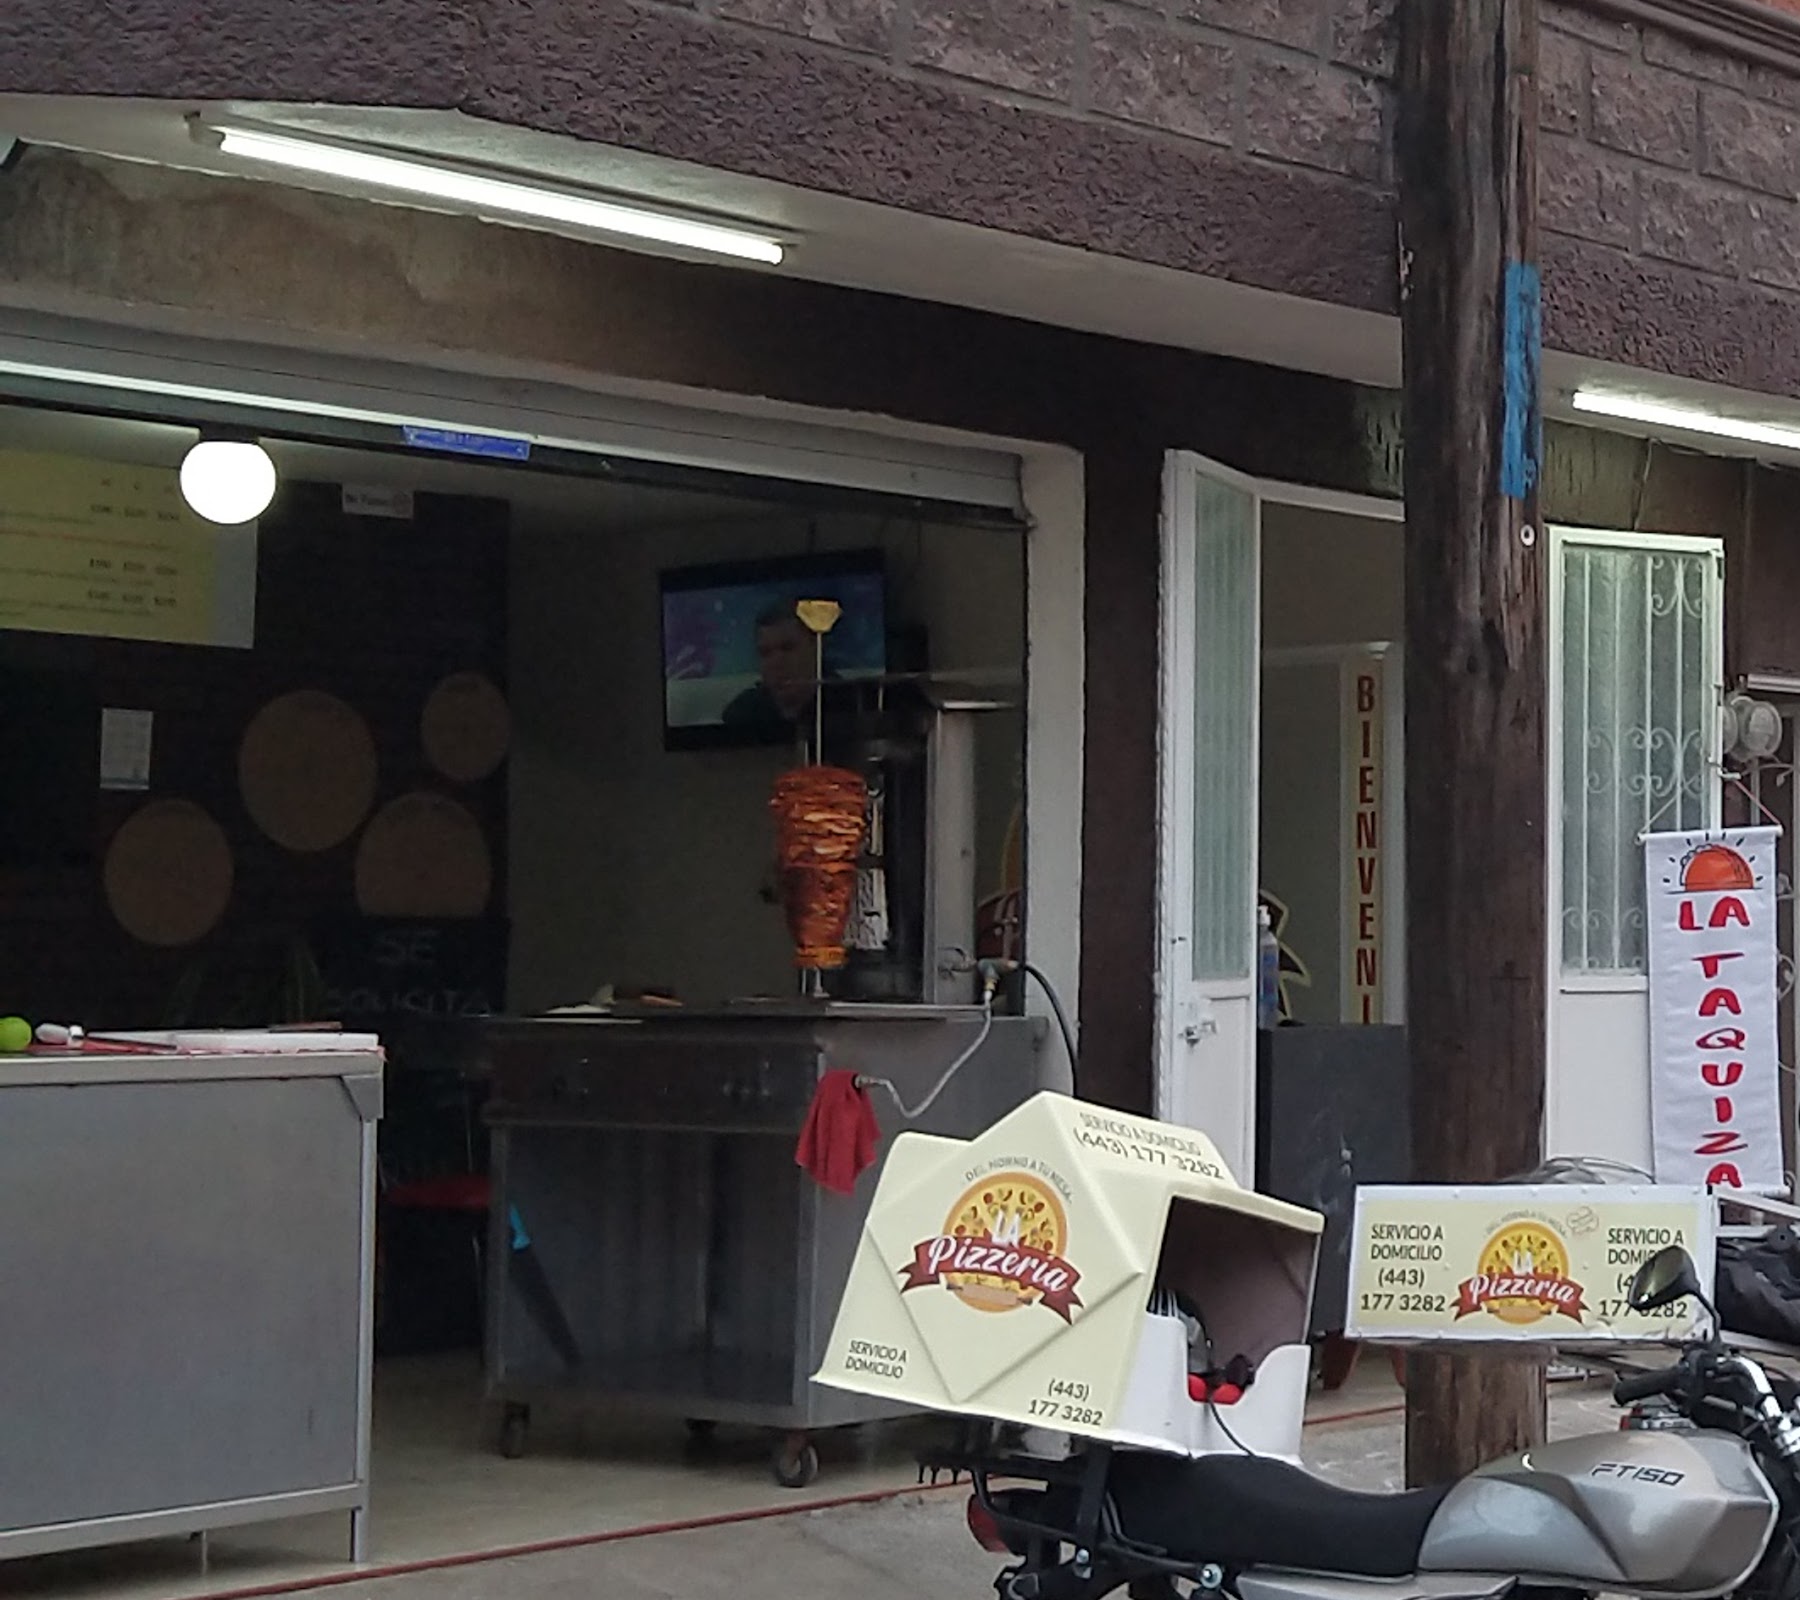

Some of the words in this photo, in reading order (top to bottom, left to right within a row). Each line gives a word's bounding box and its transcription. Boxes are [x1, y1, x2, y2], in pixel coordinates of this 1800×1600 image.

[1356, 675, 1377, 1024] BIENVENI
[1678, 896, 1750, 930] LA
[1693, 952, 1748, 1189] TAQUIZA
[1073, 1127, 1128, 1158] (443)
[1130, 1144, 1166, 1167] 177
[992, 1209, 1021, 1249] LA
[1371, 1223, 1431, 1240] SERVICIO
[1433, 1225, 1443, 1240] A
[1607, 1228, 1670, 1245] SERVICIO
[1673, 1229, 1684, 1245] A
[1371, 1244, 1442, 1261] DOMICILIO
[1513, 1250, 1534, 1277] LA
[1378, 1267, 1425, 1290] (443)
[1361, 1293, 1395, 1311] 177
[1399, 1293, 1446, 1312] 3282
[1600, 1299, 1632, 1317] 177
[849, 1340, 897, 1362] SERVICIO
[898, 1349, 907, 1363] A
[845, 1356, 903, 1379] DOMICILIO
[1048, 1379, 1089, 1401] (443)
[1028, 1399, 1058, 1418] 177
[1061, 1405, 1103, 1426] 3282
